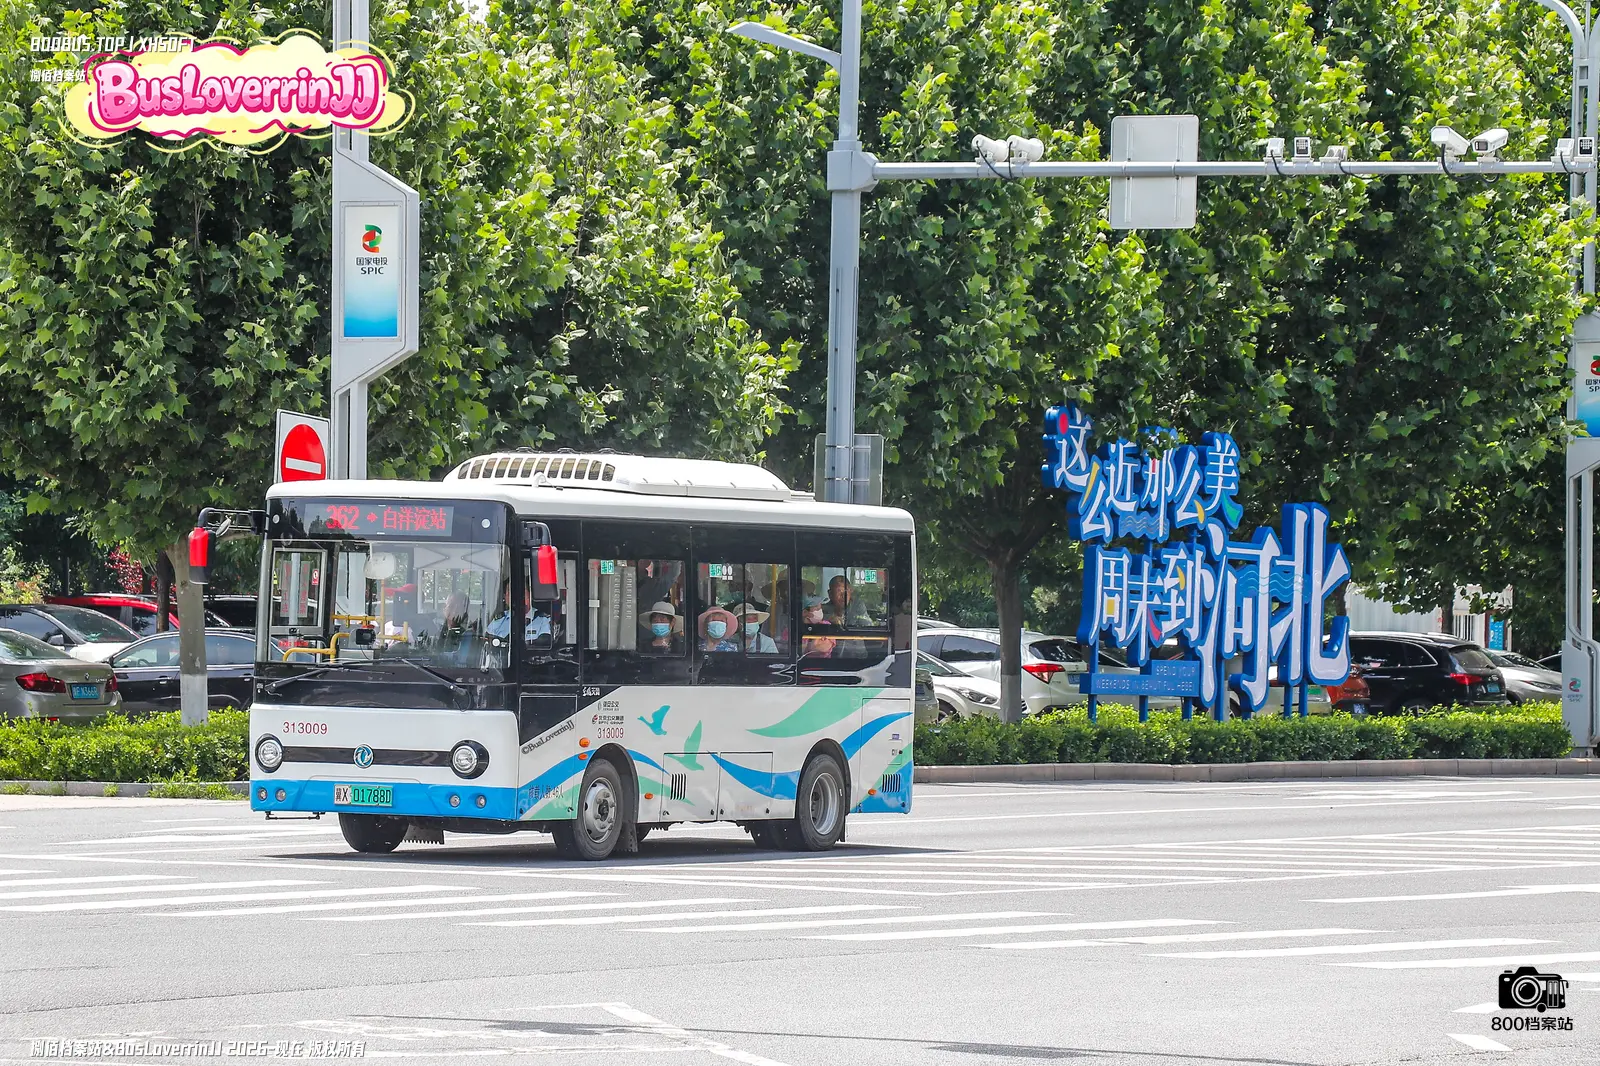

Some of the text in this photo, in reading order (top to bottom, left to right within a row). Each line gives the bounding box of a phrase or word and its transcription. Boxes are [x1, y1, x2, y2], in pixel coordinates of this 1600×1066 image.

[356, 257, 388, 266] 国家电投
[360, 266, 384, 275] SPIC
[1585, 378, 1600, 386] 国家
[1056, 407, 1242, 540] 这么近那么美
[325, 505, 447, 531] 362 白洋淀站
[1089, 508, 1351, 706] 周末到河北
[283, 721, 328, 735] 313009
[597, 727, 624, 739] 313009
